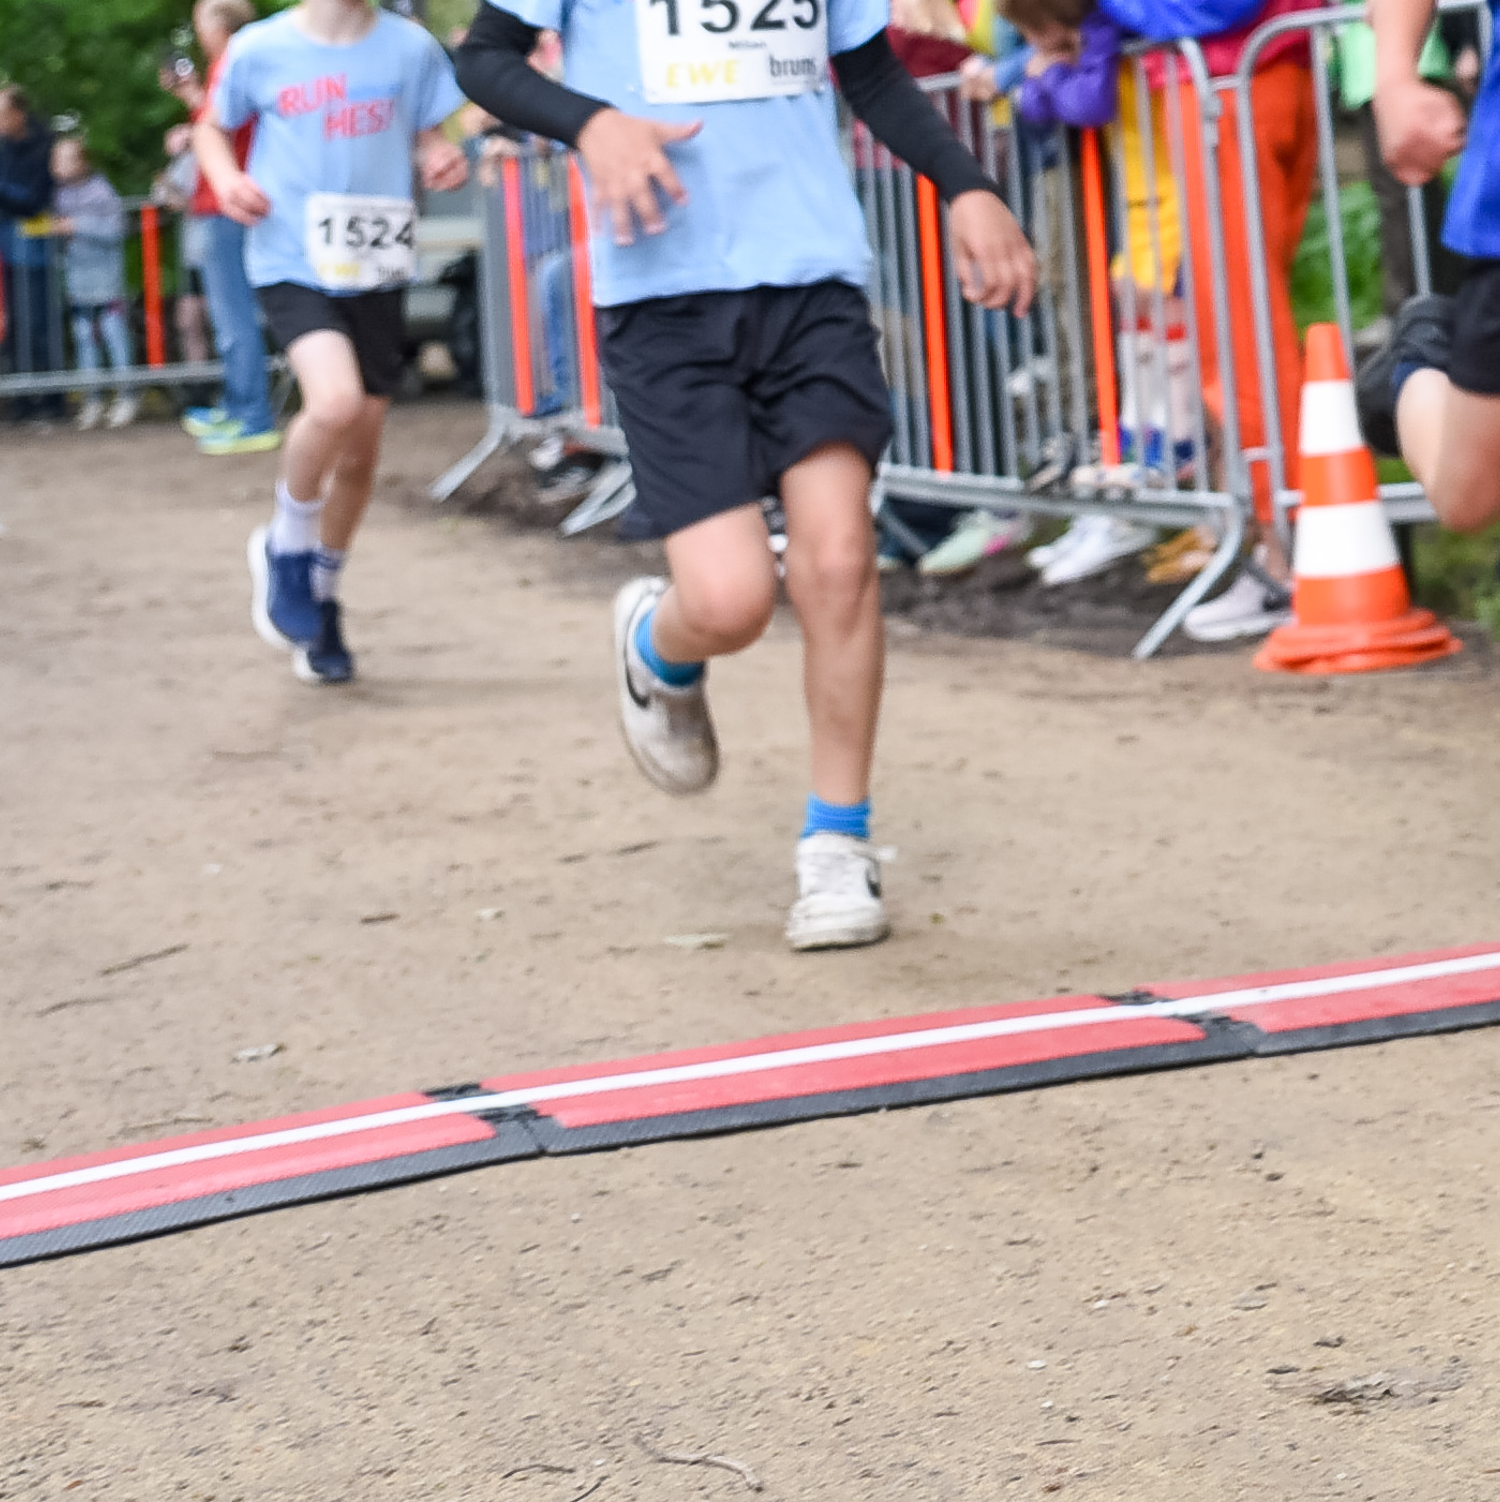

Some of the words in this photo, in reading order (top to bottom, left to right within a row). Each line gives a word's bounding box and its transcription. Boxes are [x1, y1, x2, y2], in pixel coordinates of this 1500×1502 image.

[666, 60, 739, 88] EWE
[278, 72, 346, 117] RUN
[318, 215, 414, 249] 1524
